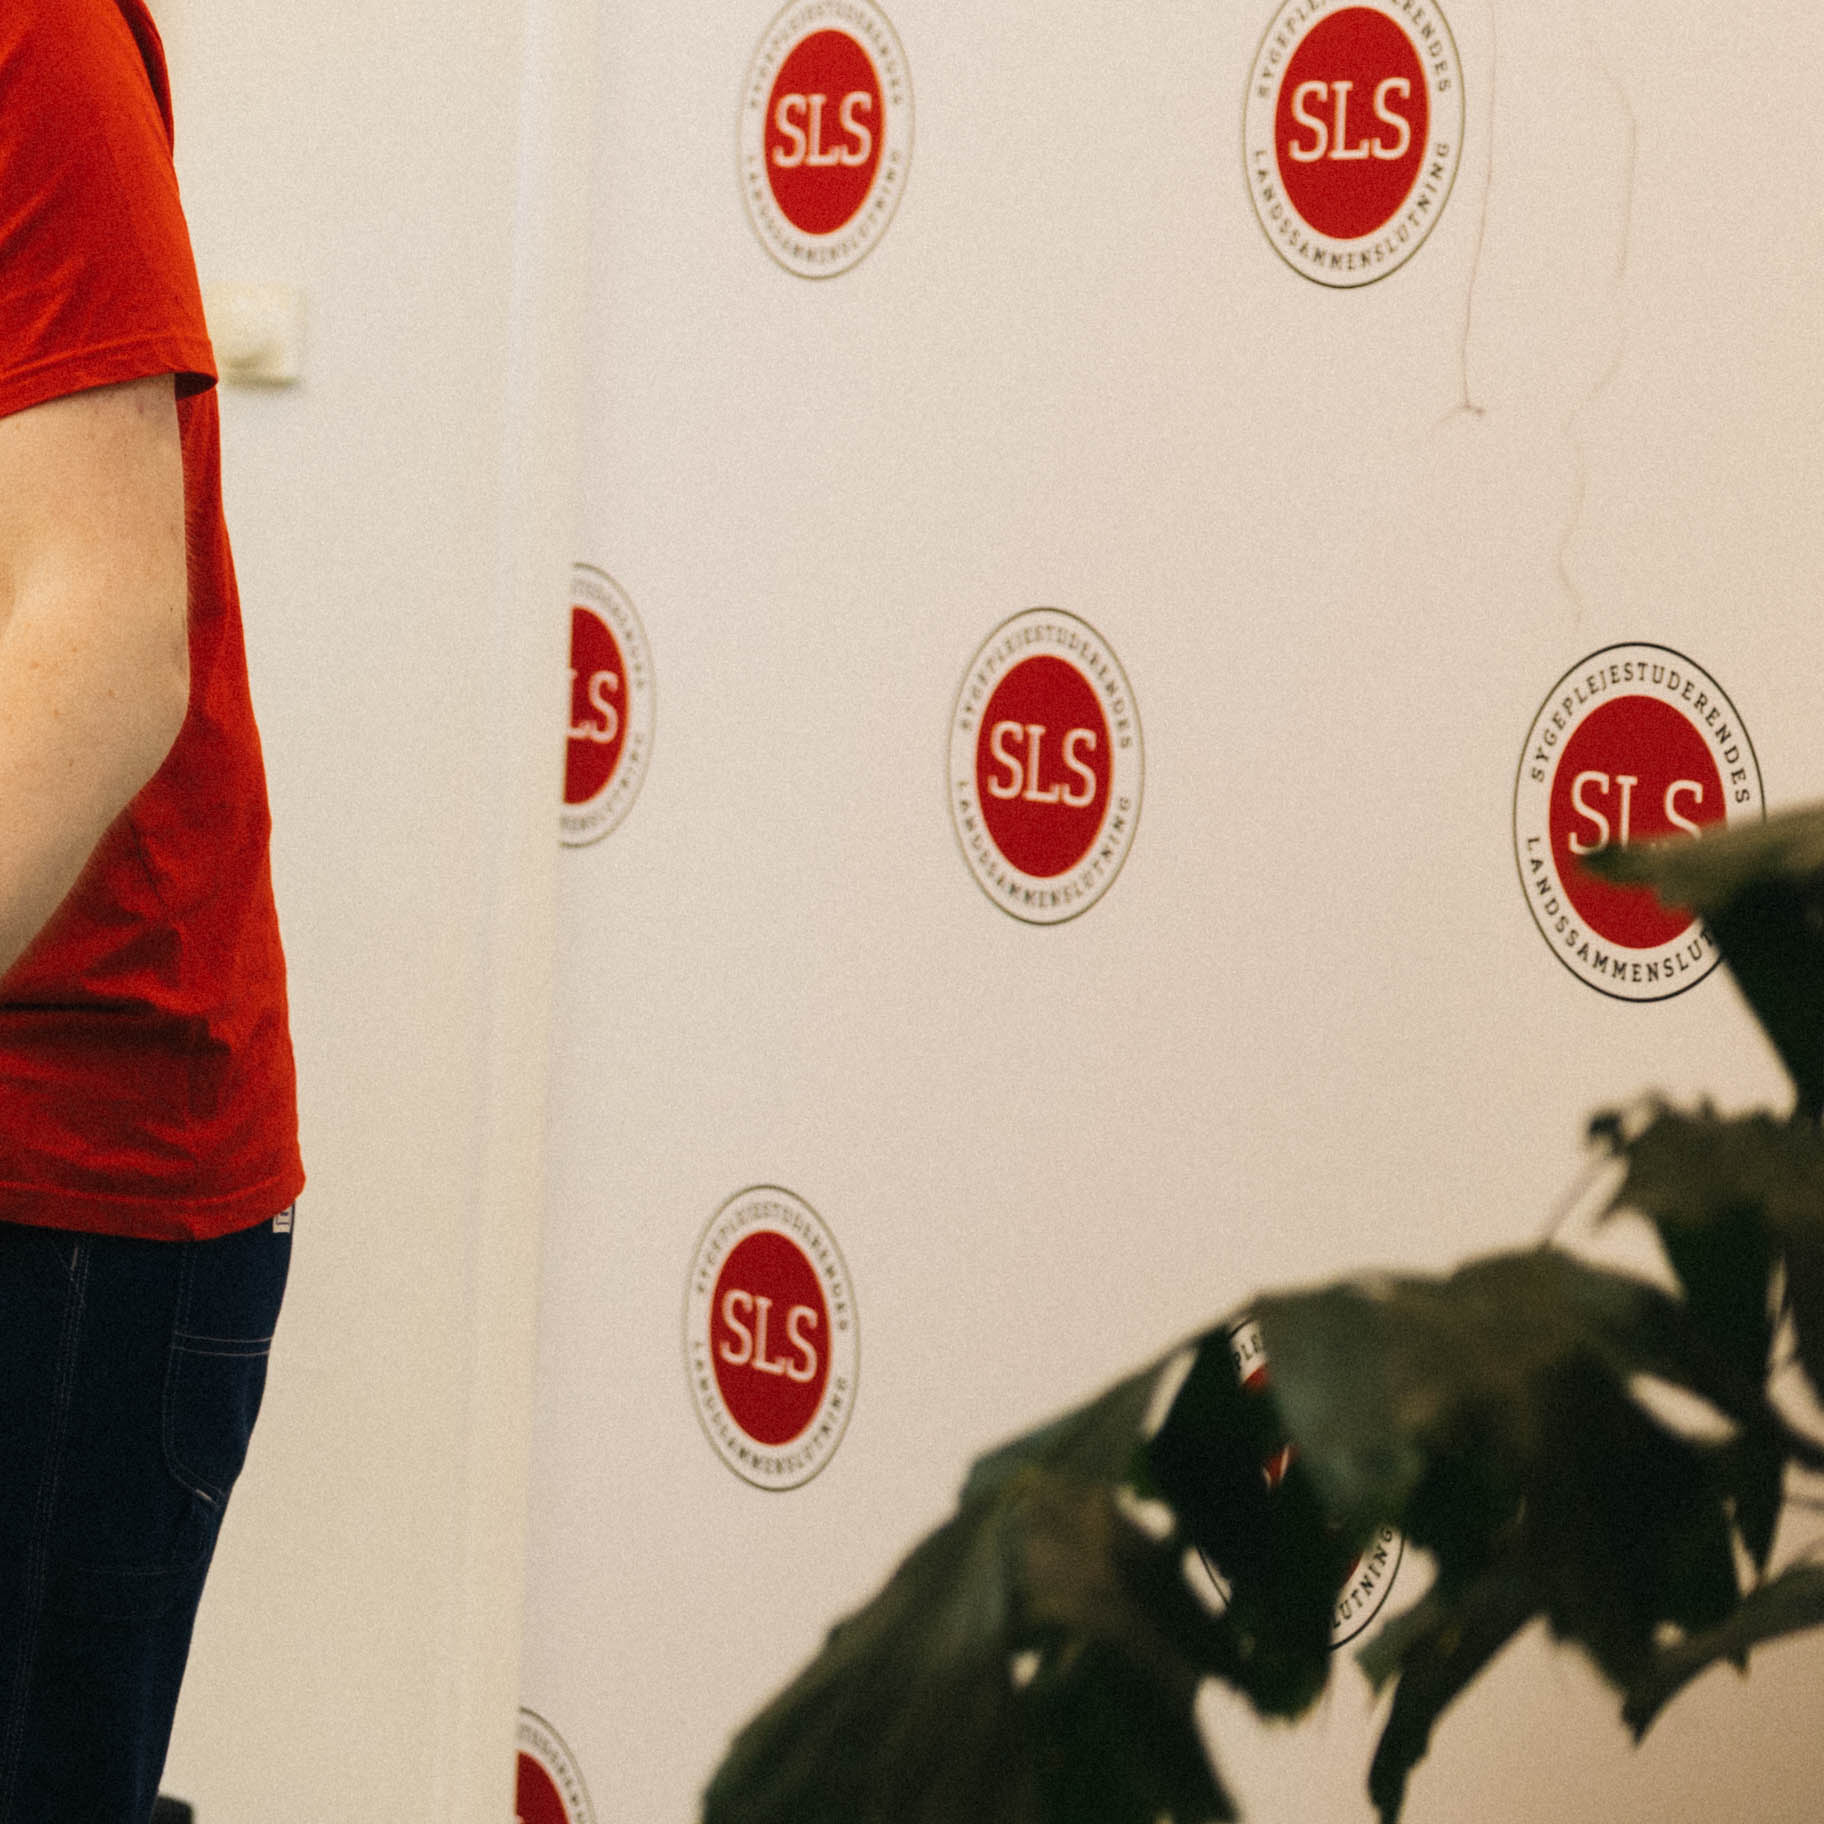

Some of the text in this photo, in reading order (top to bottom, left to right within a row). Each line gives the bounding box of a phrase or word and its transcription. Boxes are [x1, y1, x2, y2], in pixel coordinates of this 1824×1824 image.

[773, 90, 872, 168] SLS
[1289, 77, 1411, 162] SLS
[988, 721, 1097, 808] SLS
[1531, 662, 1750, 804] SYGEPLEJESTUDERENDES
[1527, 837, 1714, 982] LANDSSAMMENSLUT
[720, 1288, 818, 1383] SLS
